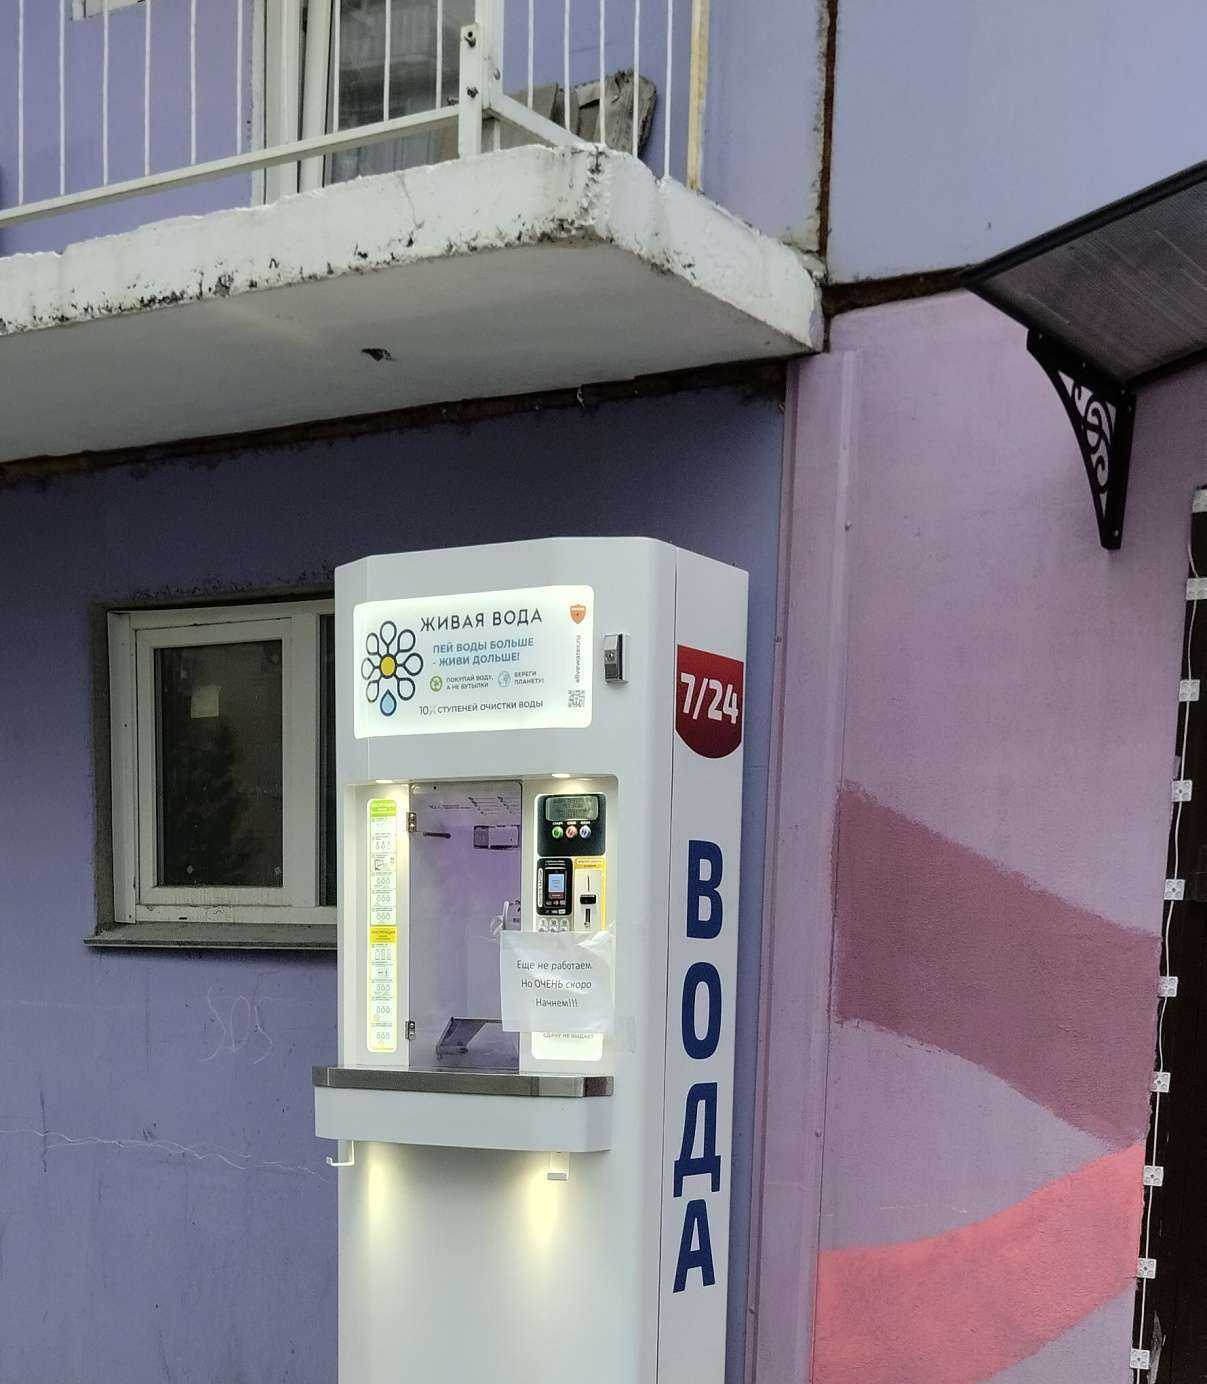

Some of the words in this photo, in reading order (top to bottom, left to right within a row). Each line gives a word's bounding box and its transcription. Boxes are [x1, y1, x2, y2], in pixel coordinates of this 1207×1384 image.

[420, 613, 484, 632] ЖИВАЯ
[492, 608, 542, 627] ВОДА
[433, 644, 453, 653] ПЕЙ
[456, 641, 487, 653] ВОДЫ
[490, 637, 534, 650] БОЛЬШЕ
[439, 658, 470, 667] ЖИВИ
[472, 652, 520, 665] ДОЛЬШЕ!
[680, 671, 739, 725] 7/24
[437, 704, 478, 714] СТУПЕНЕЙ
[480, 702, 517, 711] ОЧИСТКИ
[519, 700, 543, 709] ВОДЫ
[517, 960, 535, 969] Еще
[551, 961, 592, 971] работаем
[521, 980, 533, 988] Но
[534, 980, 563, 989] ОЧЕНЬ
[565, 982, 592, 990] скоро
[672, 838, 725, 1294] ВОДА
